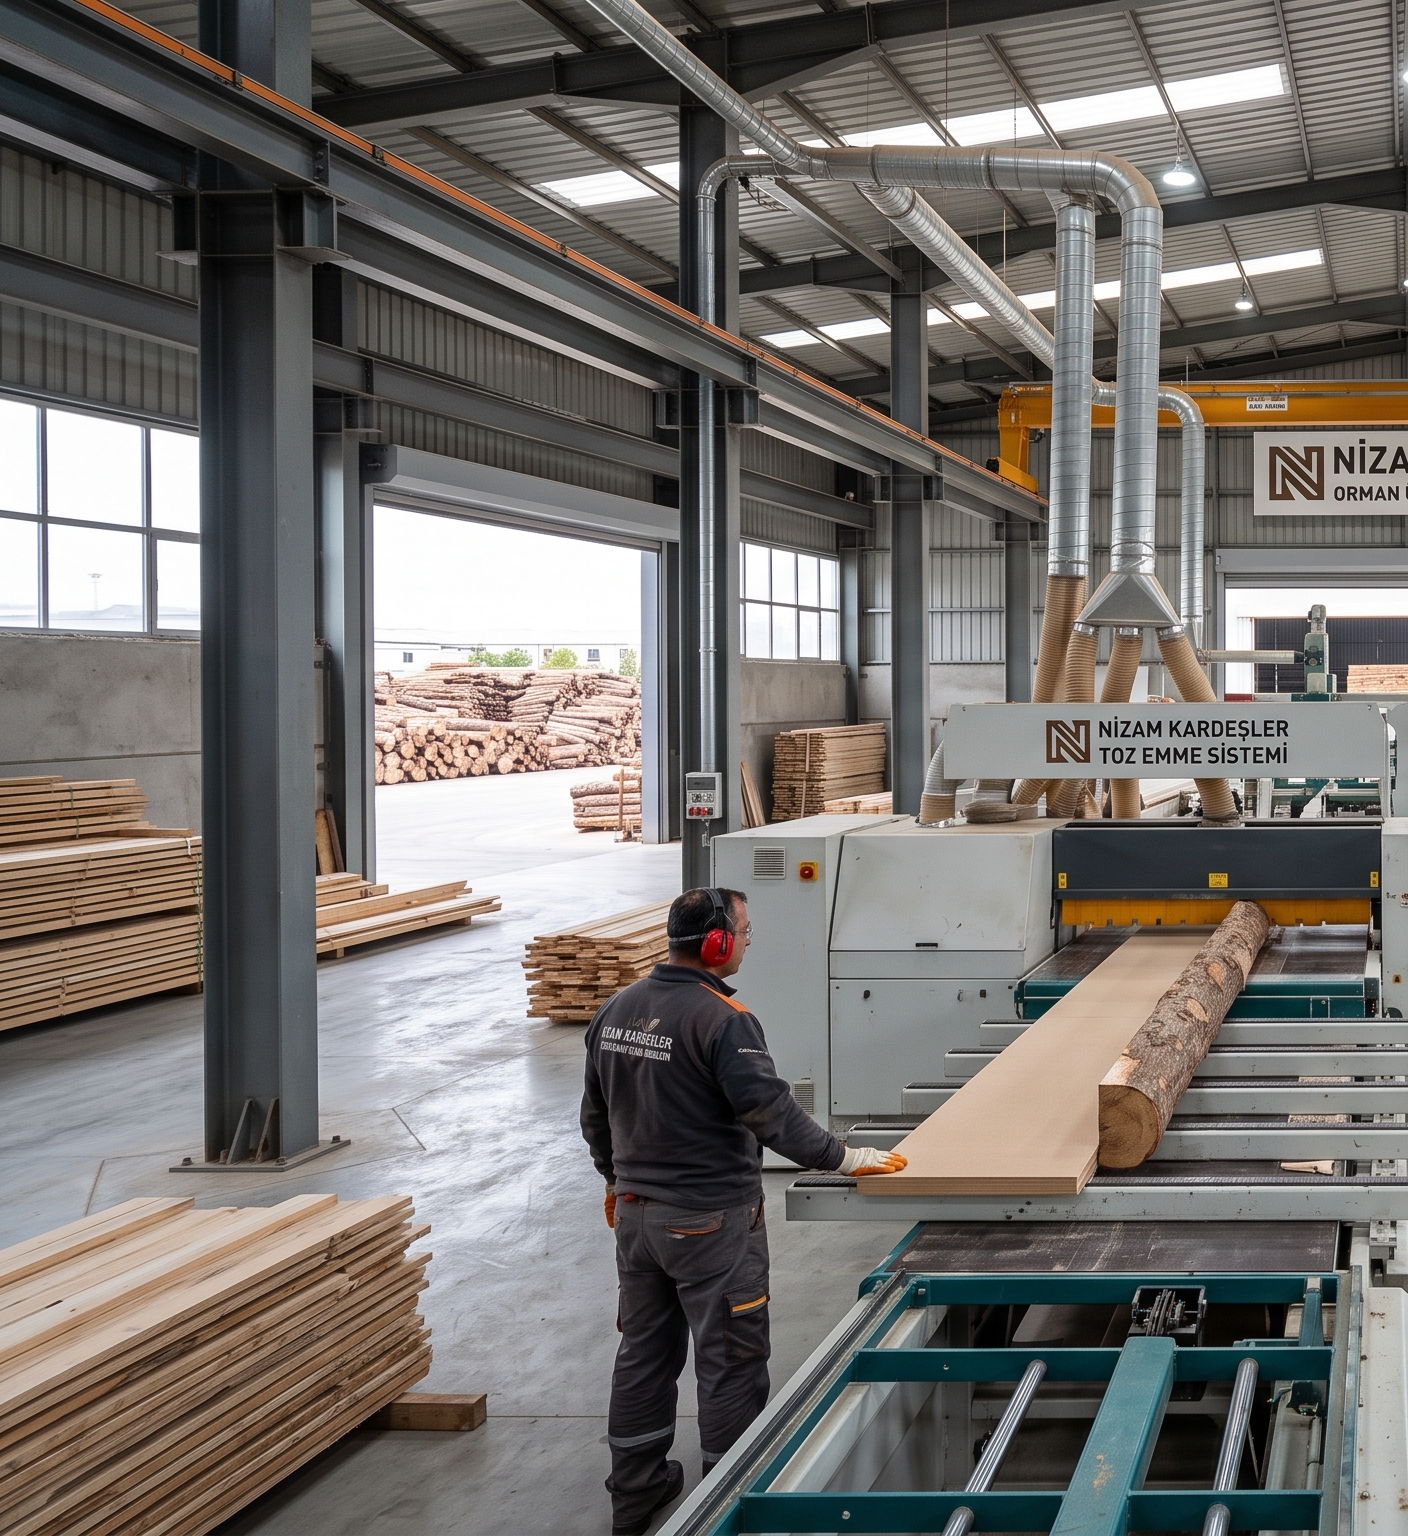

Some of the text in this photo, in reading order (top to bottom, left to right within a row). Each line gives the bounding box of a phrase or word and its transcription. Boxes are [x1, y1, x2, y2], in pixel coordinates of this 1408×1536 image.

[1333, 485, 1399, 502] ORMAN
[1098, 716, 1289, 742] NİZAM KARDEŞLER
[1099, 742, 1288, 765] TOZ EMME SİSTEMİ
